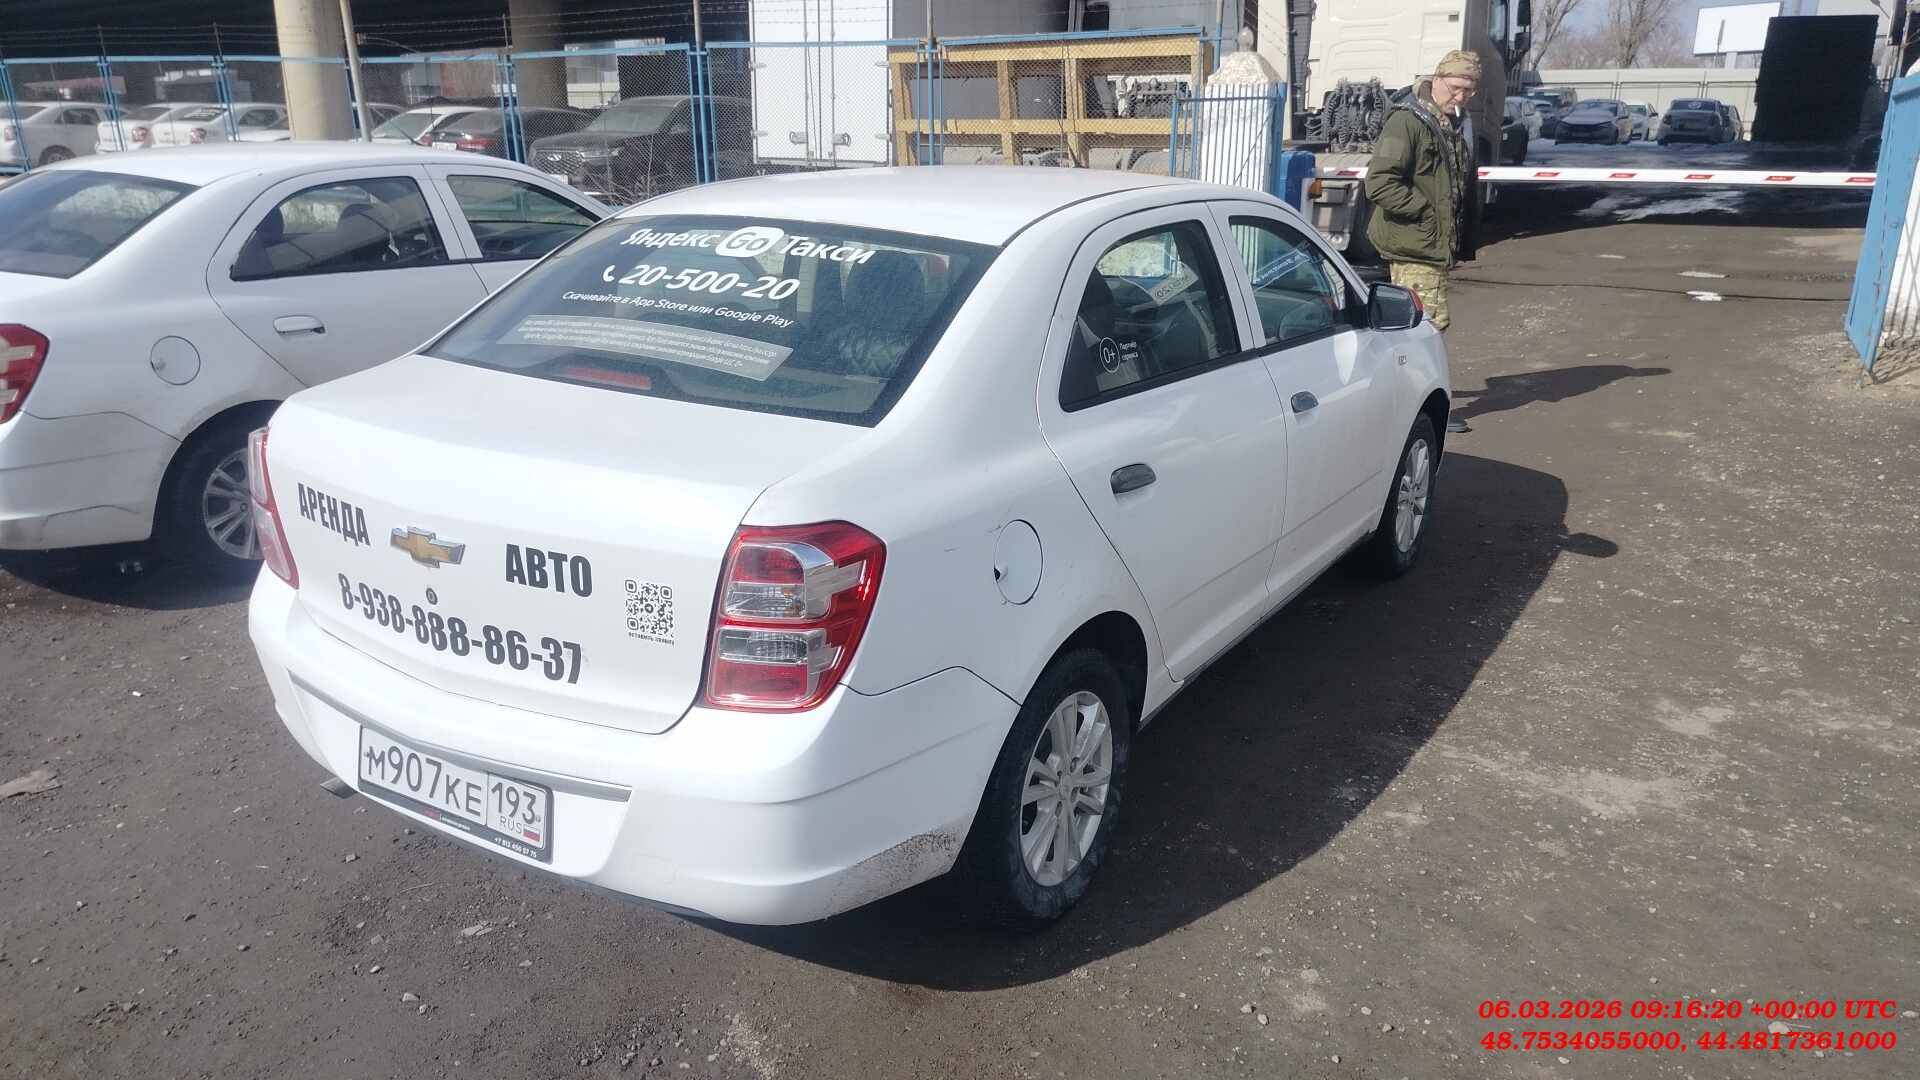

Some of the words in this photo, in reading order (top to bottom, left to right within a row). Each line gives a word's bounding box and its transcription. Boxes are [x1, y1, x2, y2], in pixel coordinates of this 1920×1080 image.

[620, 228, 720, 249] Яндекс
[779, 235, 876, 264] Такси
[619, 264, 800, 300] 20-500-20
[562, 291, 620, 303] Скачивайте
[630, 296, 655, 307] App
[654, 299, 687, 311] Store
[688, 305, 713, 314] или
[714, 307, 761, 322] Google
[762, 314, 794, 328] Play
[297, 482, 371, 547] АРЕНДА
[506, 543, 593, 598] АВТО
[337, 572, 583, 684] 8-938-888-86-37
[491, 782, 537, 825] 193
[500, 816, 522, 834] RUS
